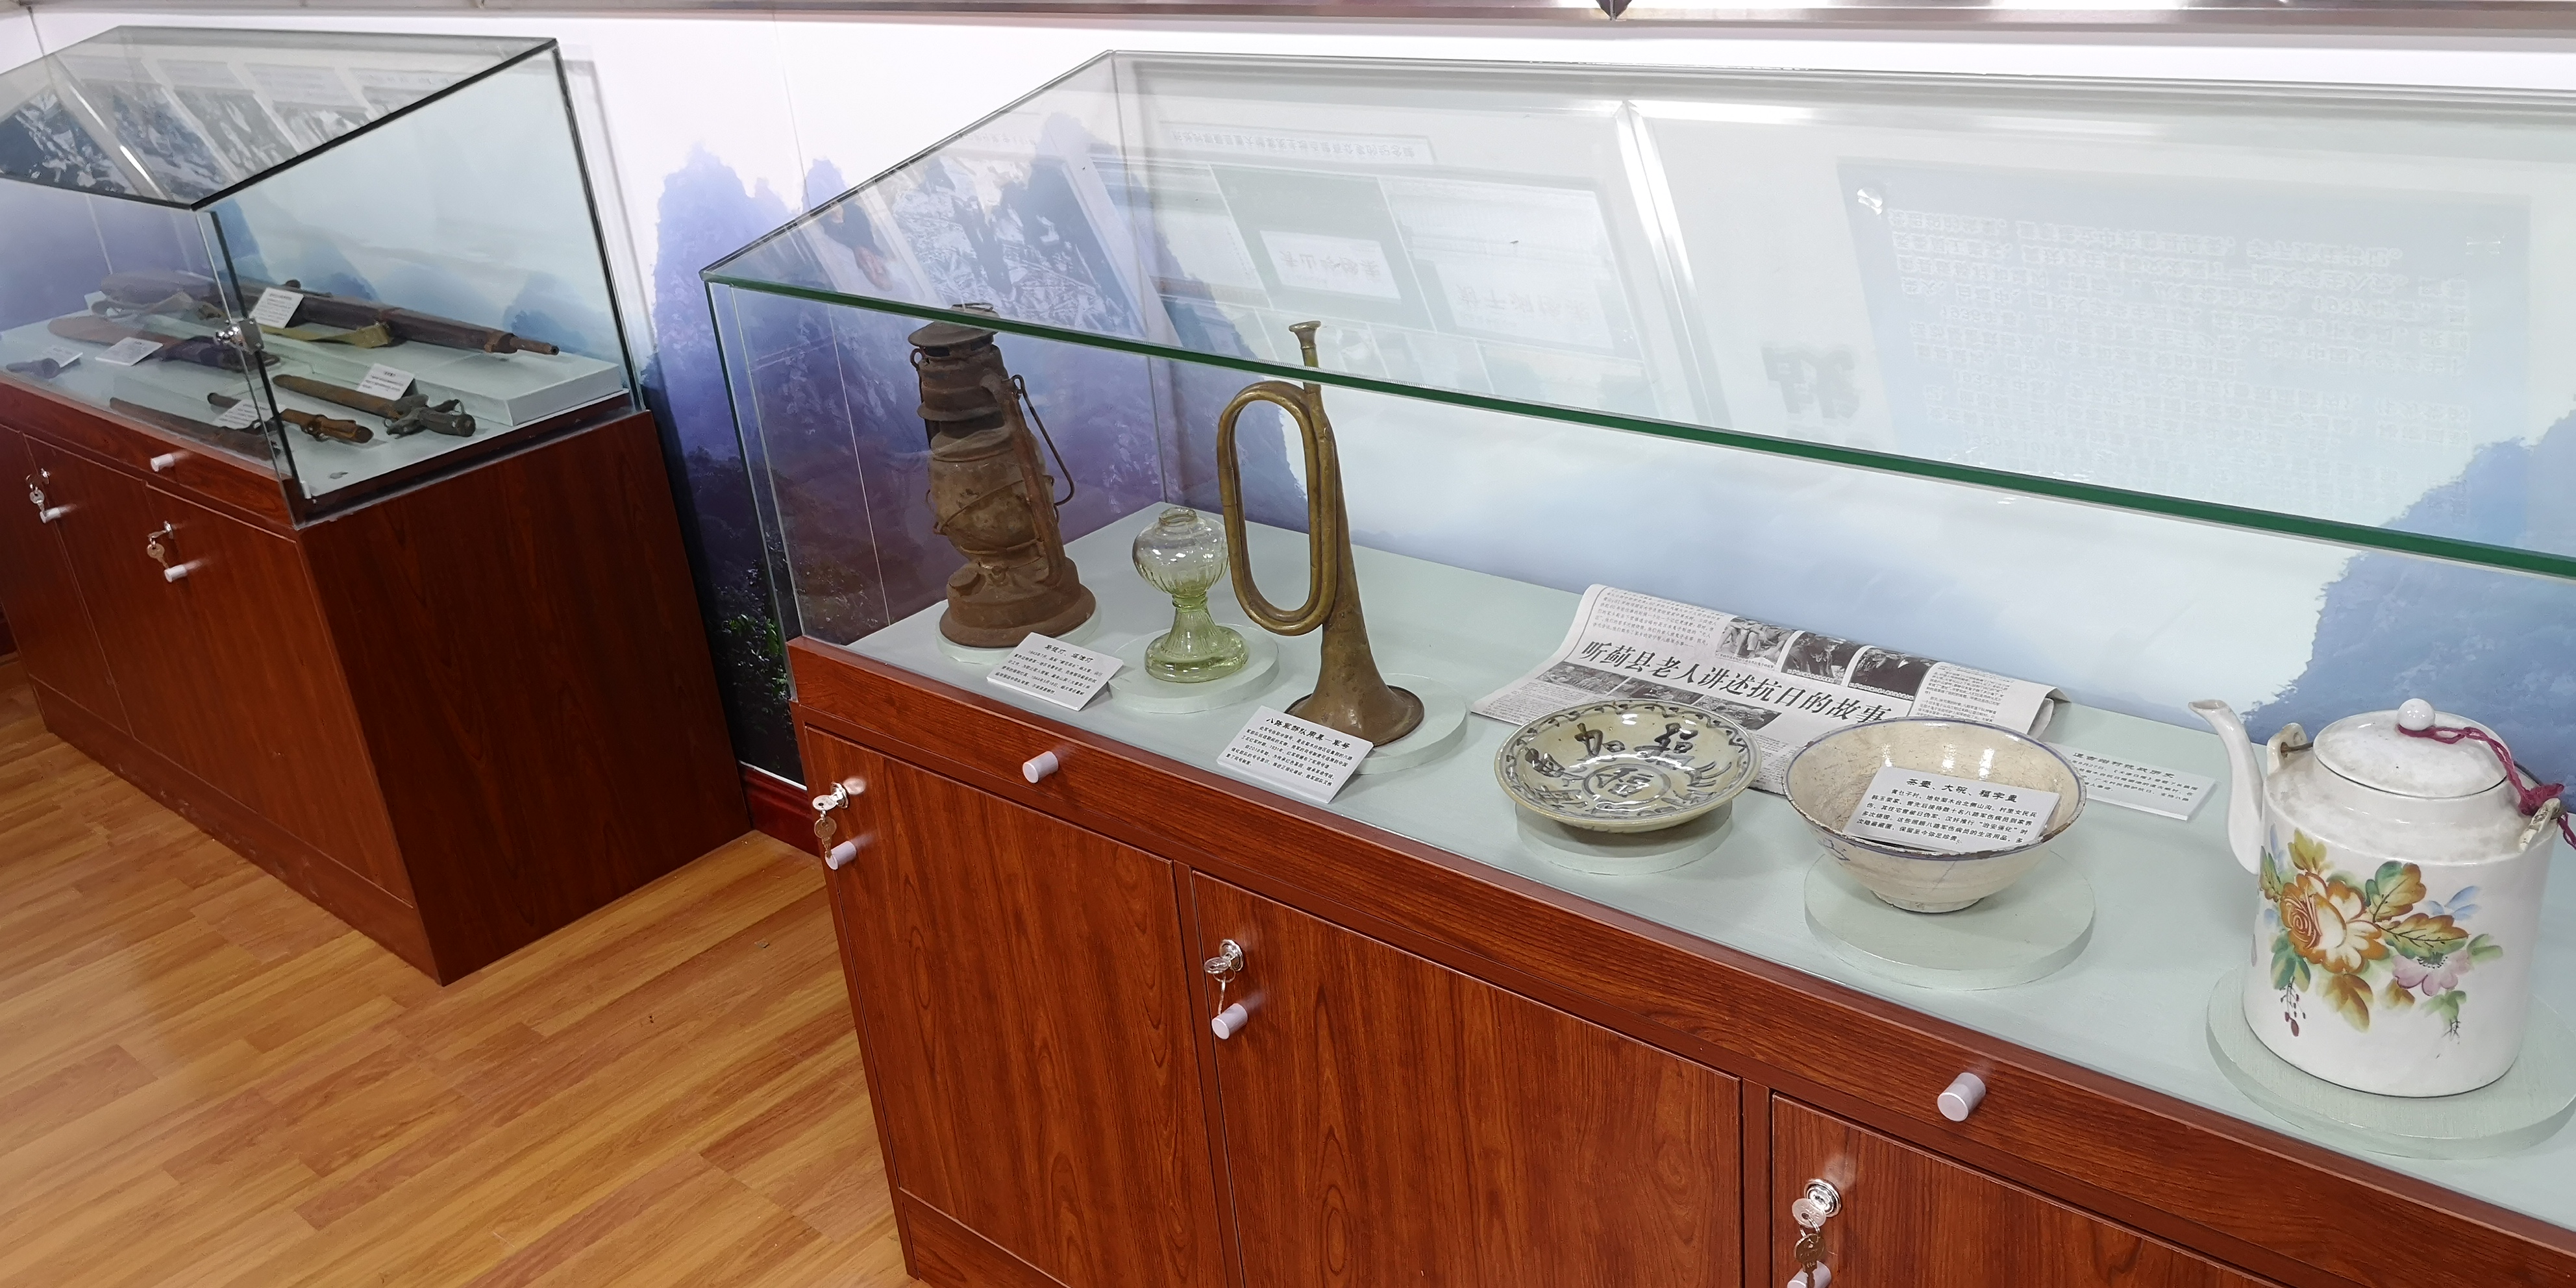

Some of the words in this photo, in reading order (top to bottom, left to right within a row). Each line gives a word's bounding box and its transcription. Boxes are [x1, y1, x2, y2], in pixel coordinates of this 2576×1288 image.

[1579, 639, 1892, 723] 听蓟县老人讲述抗日的故事
